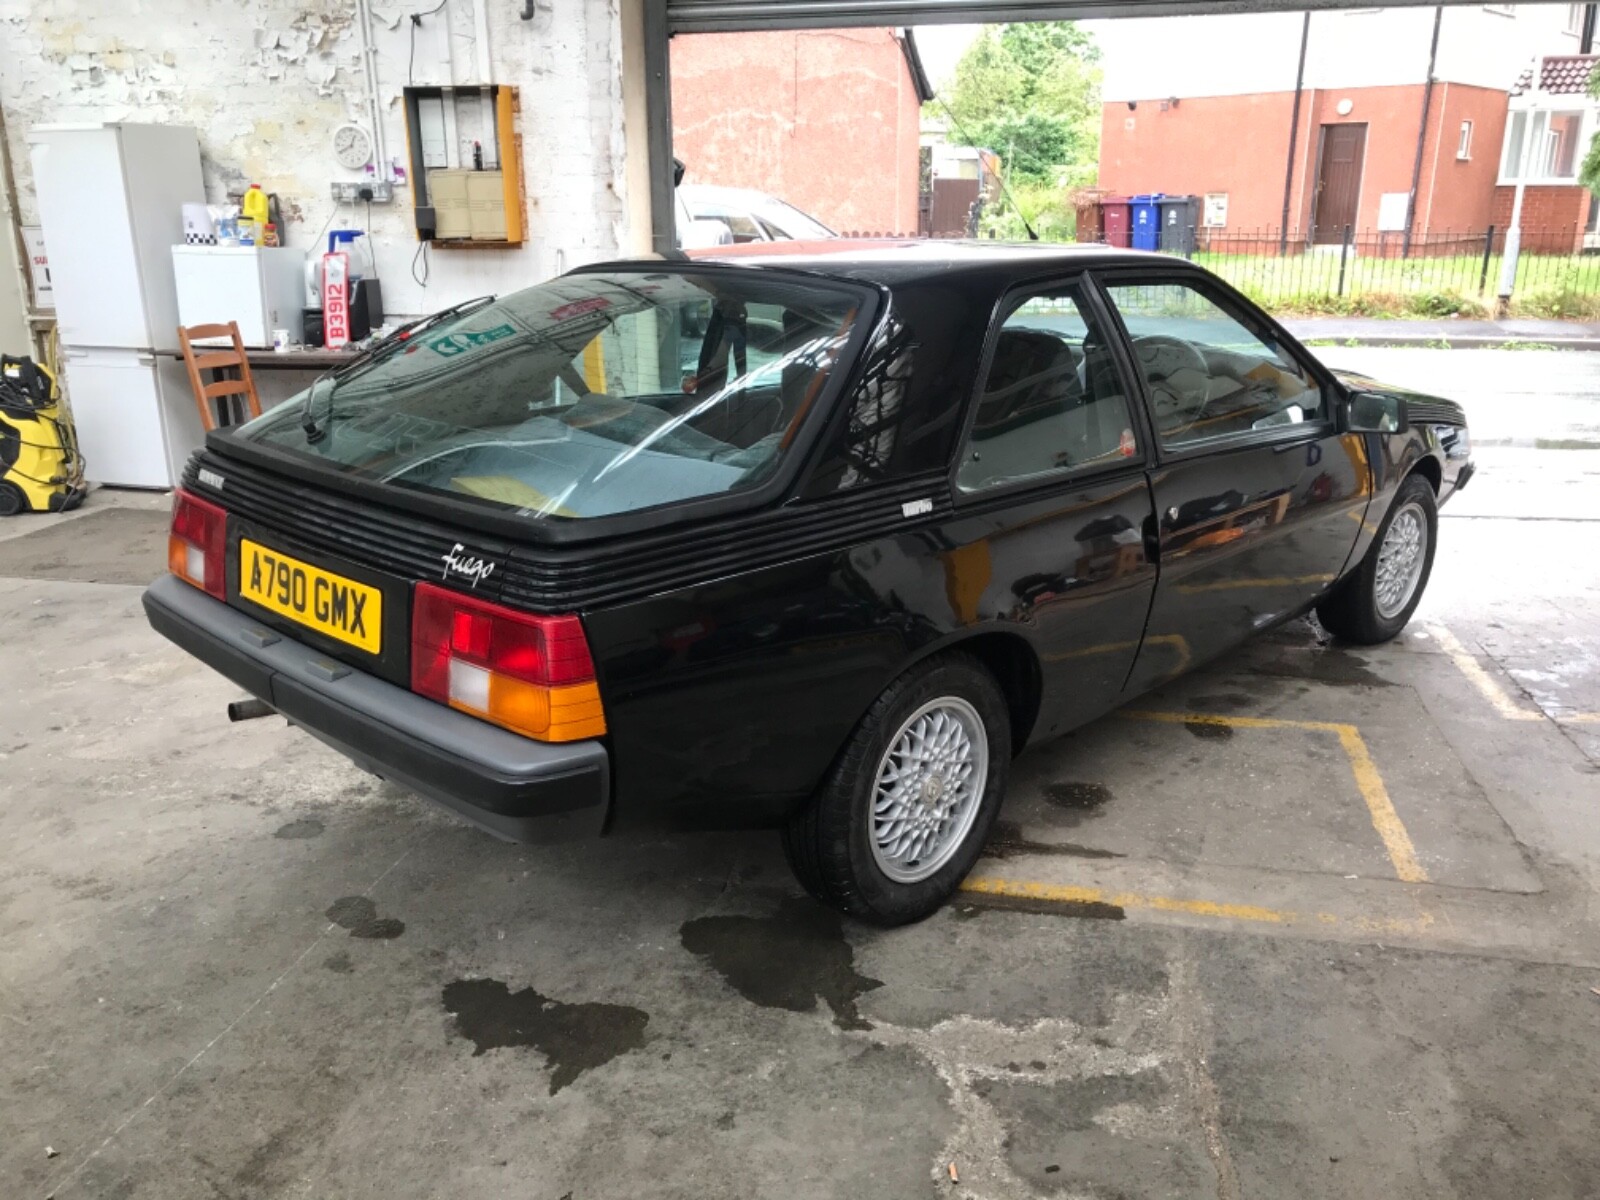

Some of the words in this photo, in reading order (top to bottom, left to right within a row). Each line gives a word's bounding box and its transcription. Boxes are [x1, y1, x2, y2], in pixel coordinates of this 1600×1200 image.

[328, 284, 345, 338] B3912
[441, 543, 495, 588] fuego
[251, 550, 306, 613] A790
[314, 576, 367, 639] GMX
